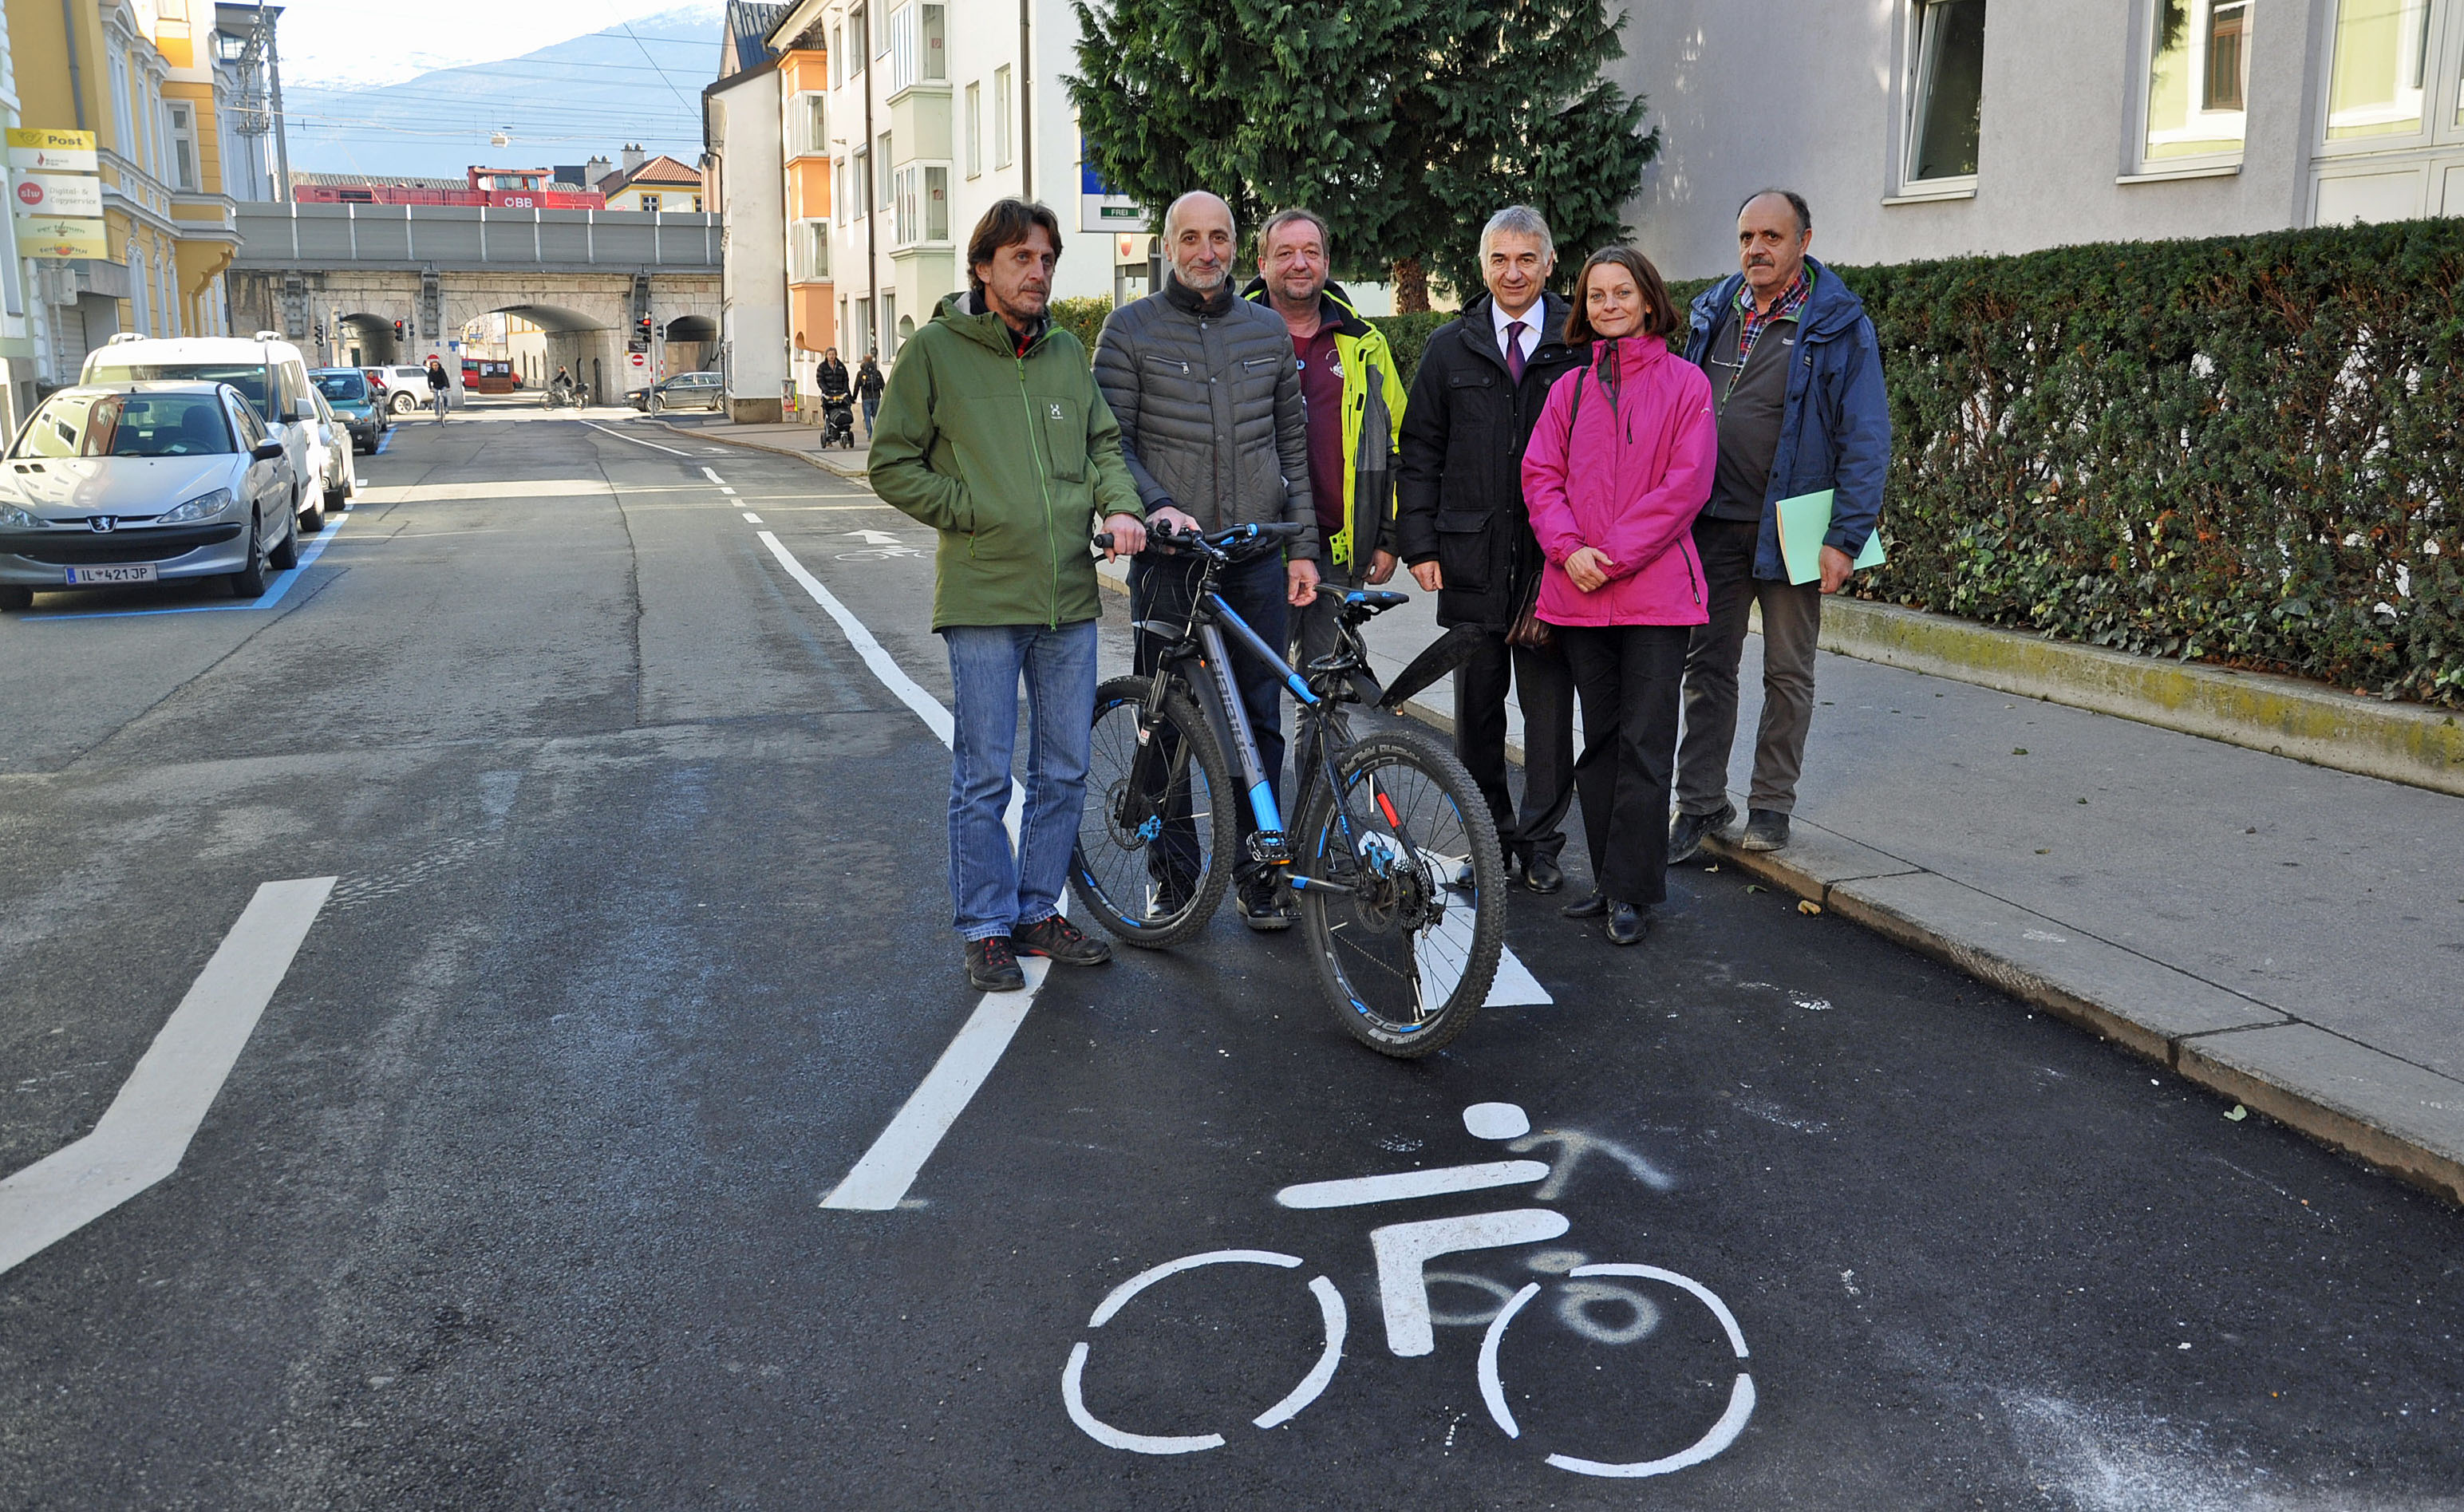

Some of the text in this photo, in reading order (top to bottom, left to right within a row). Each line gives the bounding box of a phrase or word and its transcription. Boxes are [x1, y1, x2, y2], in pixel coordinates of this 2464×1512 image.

[48, 135, 83, 146] Post
[20, 188, 40, 198] slw
[504, 196, 533, 208] ÖBB
